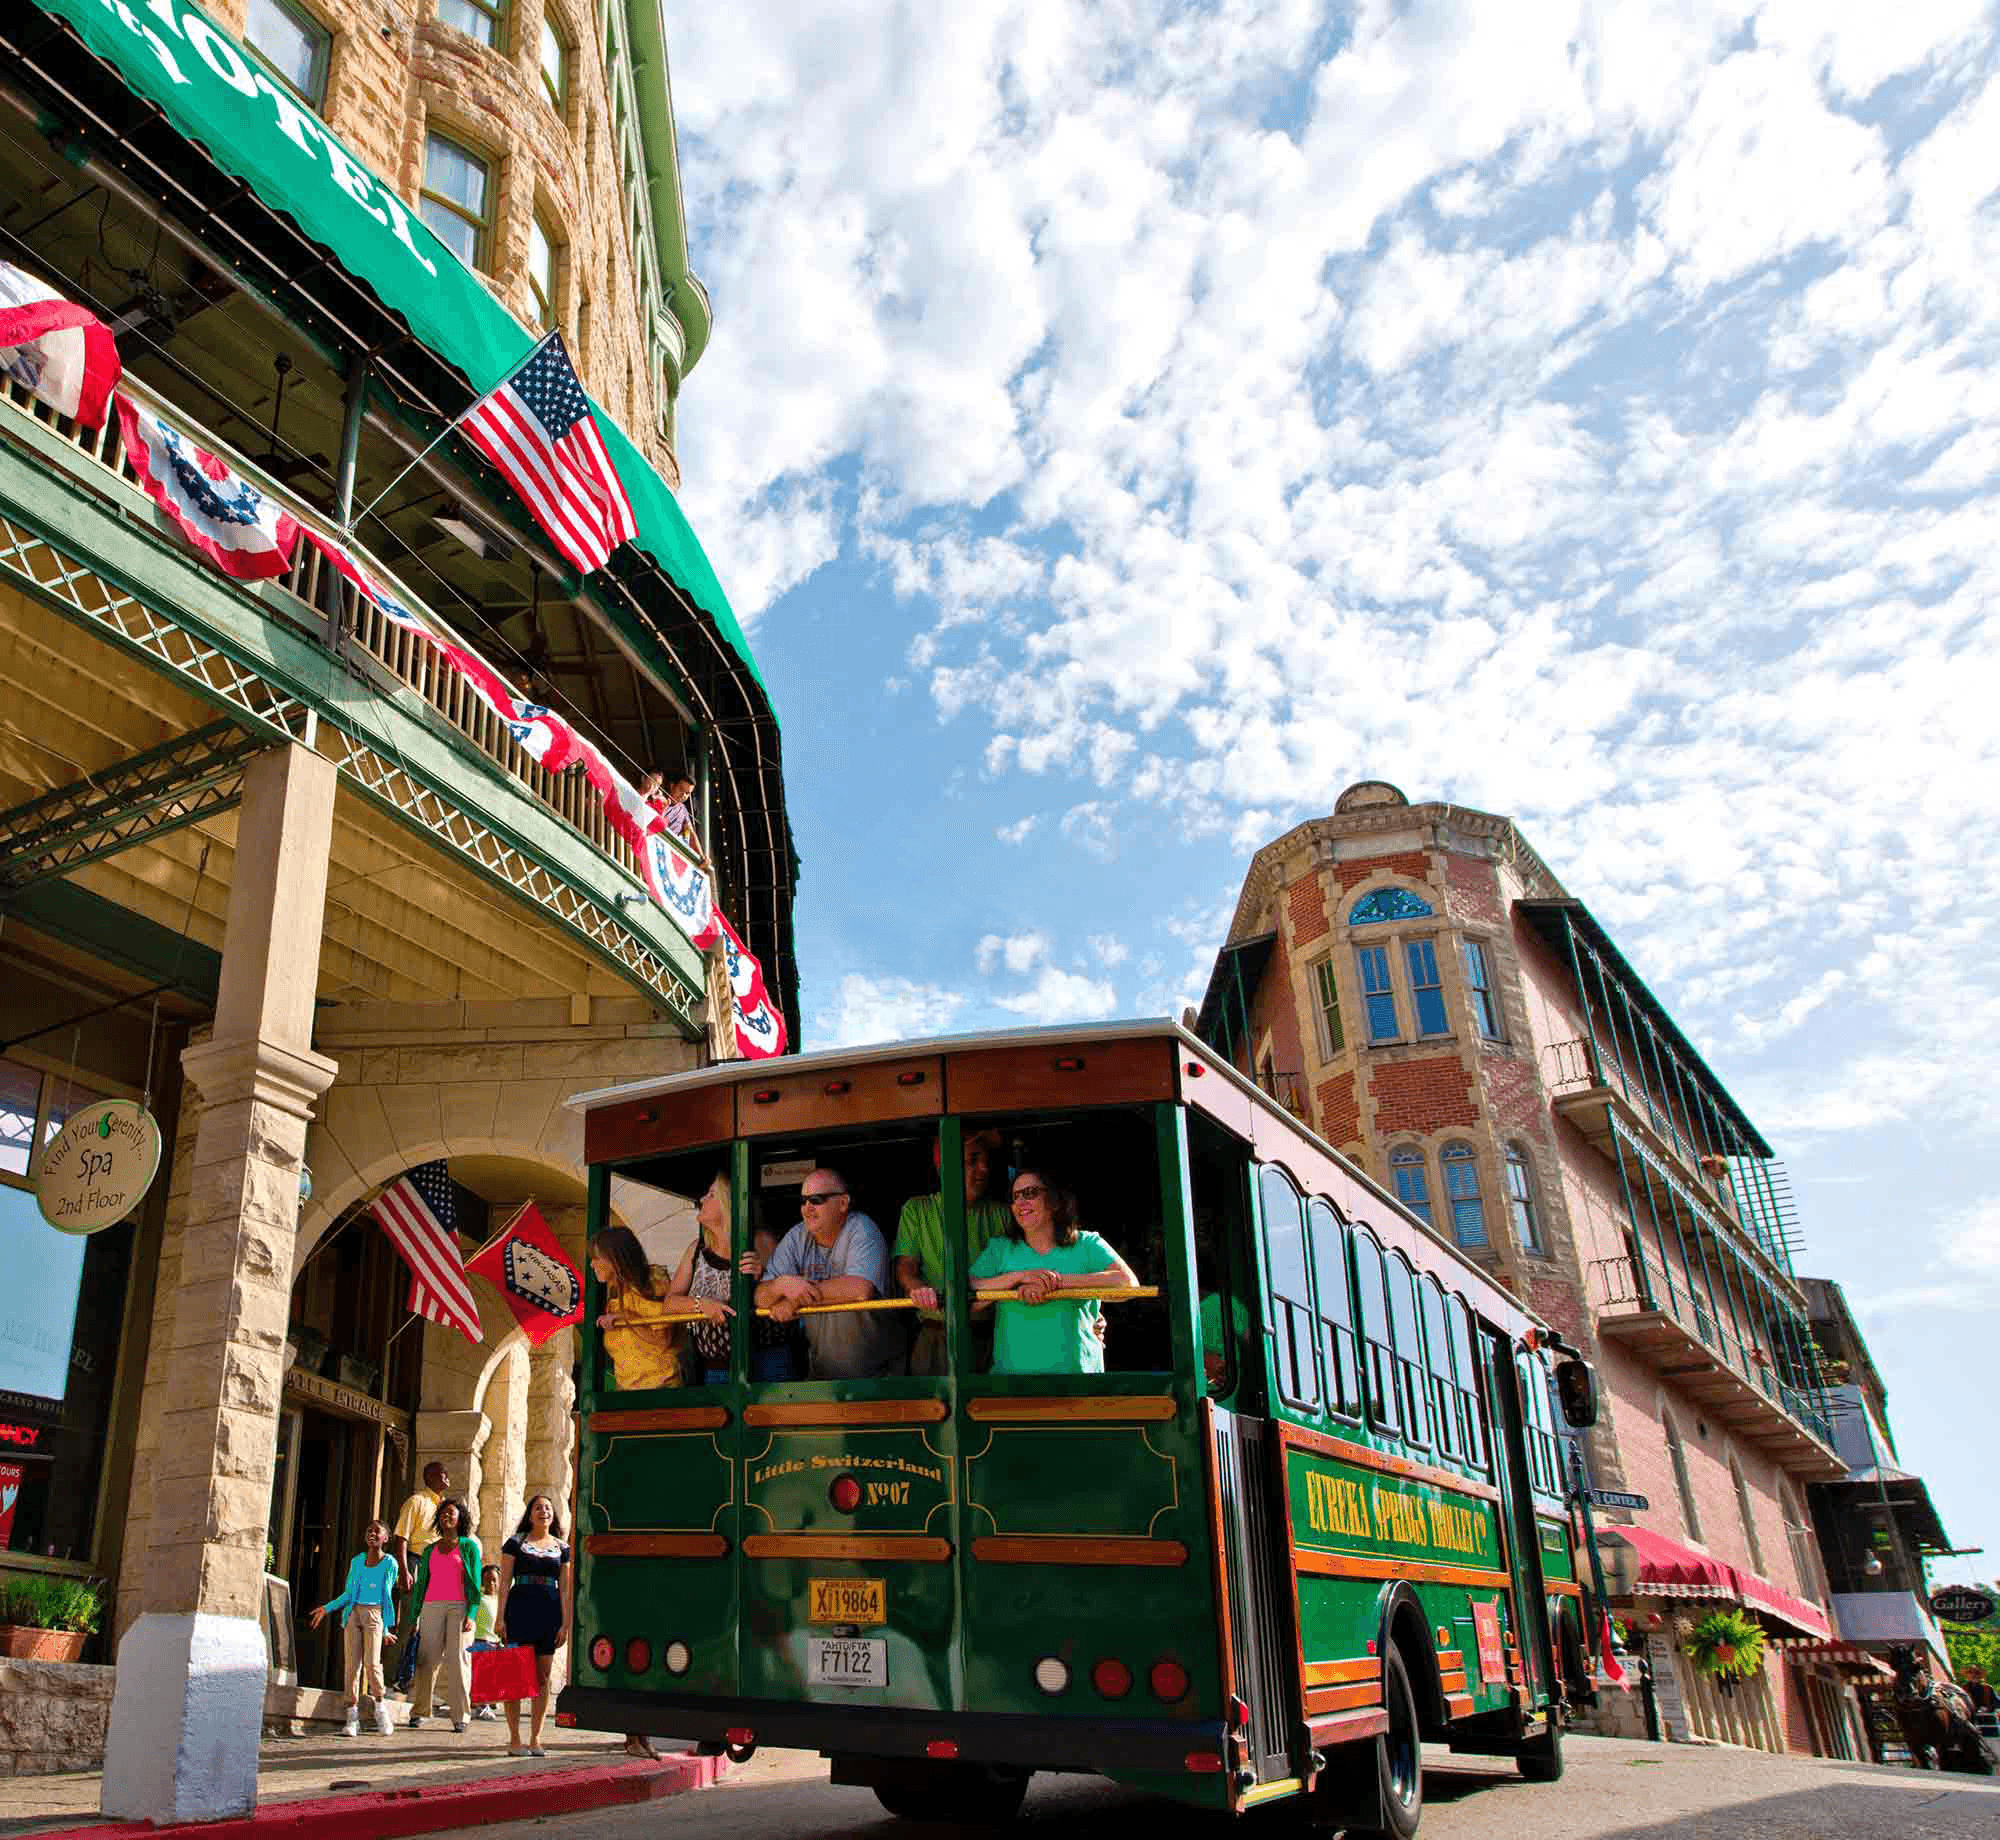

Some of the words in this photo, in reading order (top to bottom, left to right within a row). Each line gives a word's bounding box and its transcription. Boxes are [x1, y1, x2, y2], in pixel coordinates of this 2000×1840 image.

[44, 1135, 70, 1175] Find
[72, 1121, 98, 1144] Your
[76, 1143, 113, 1186] Spa
[56, 1193, 83, 1216] 2nd
[86, 1188, 126, 1211] Floor
[755, 1459, 805, 1484] Little
[811, 1455, 944, 1482] Switzerland
[1305, 1470, 1372, 1537] EUREKA
[1933, 1595, 1988, 1612] Gallery
[821, 1650, 872, 1674] F7122
